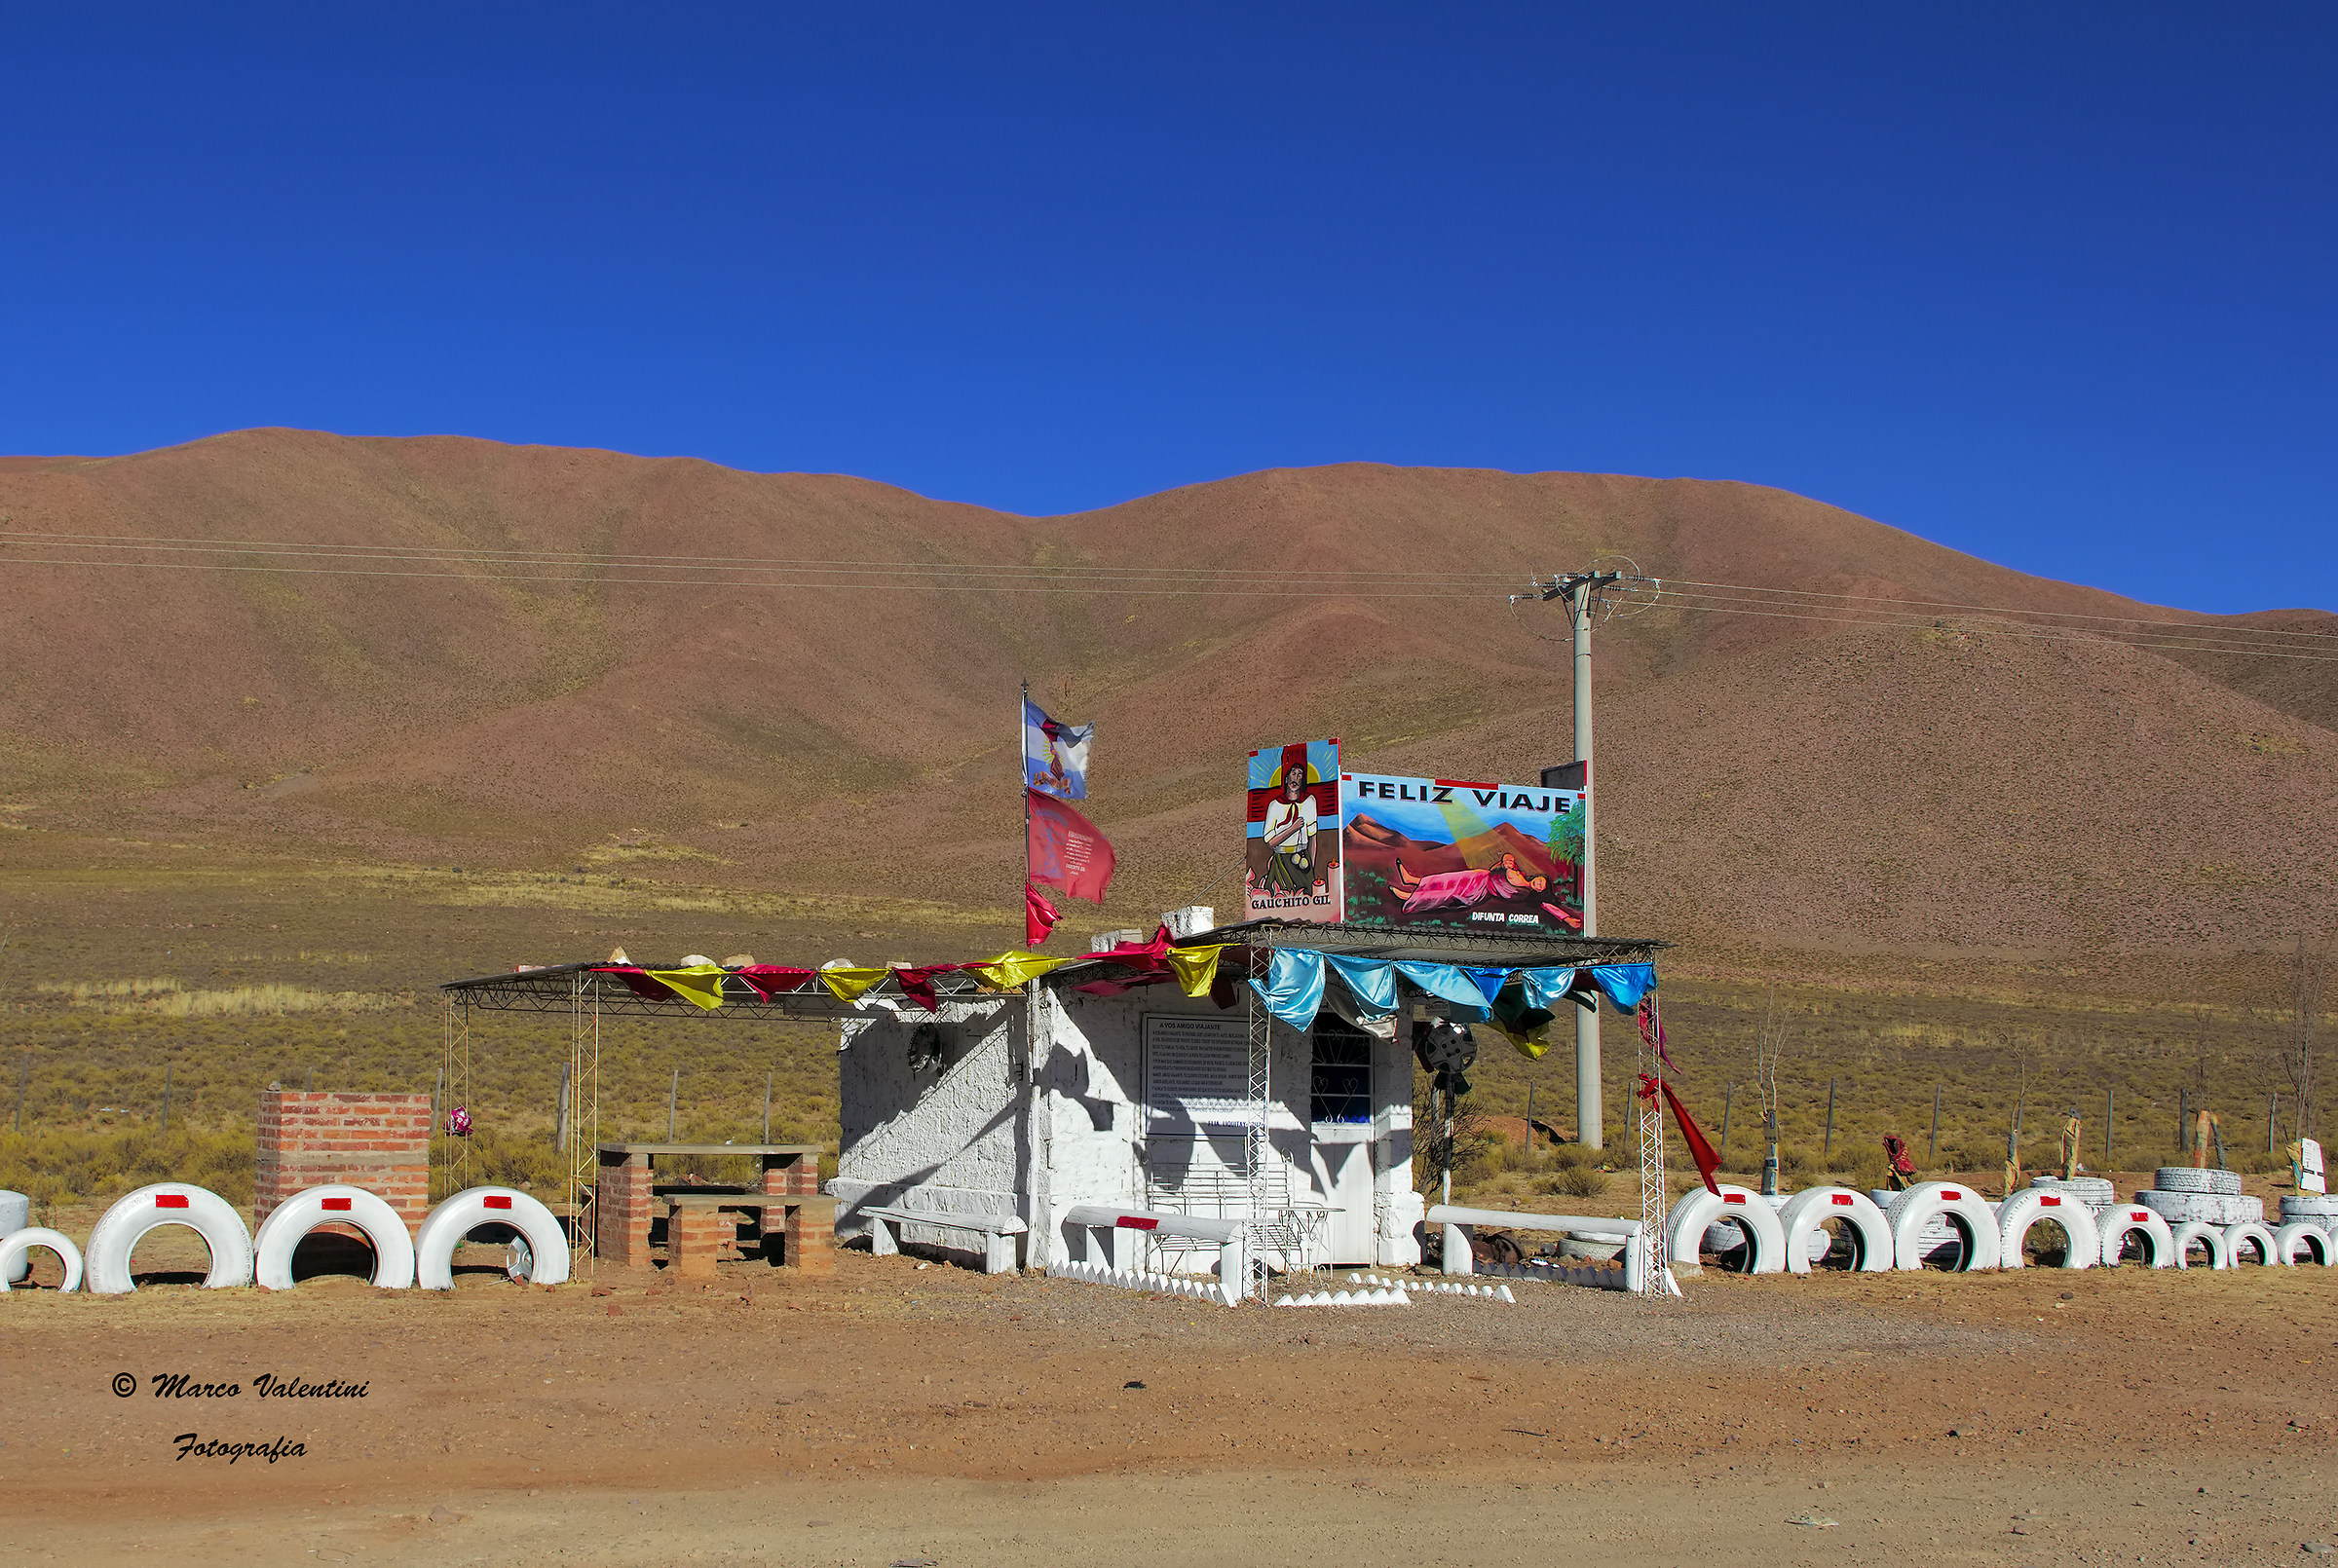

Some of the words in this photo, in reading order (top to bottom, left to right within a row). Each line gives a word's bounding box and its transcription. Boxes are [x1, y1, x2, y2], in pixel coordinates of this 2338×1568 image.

[1358, 781, 1454, 803] FELIZ
[1472, 790, 1571, 814] VIAJE
[1252, 896, 1309, 910] GAUCHITO
[1312, 894, 1331, 905] GIL
[1471, 912, 1505, 922] DIFUNTA
[1508, 914, 1539, 924] CORREA
